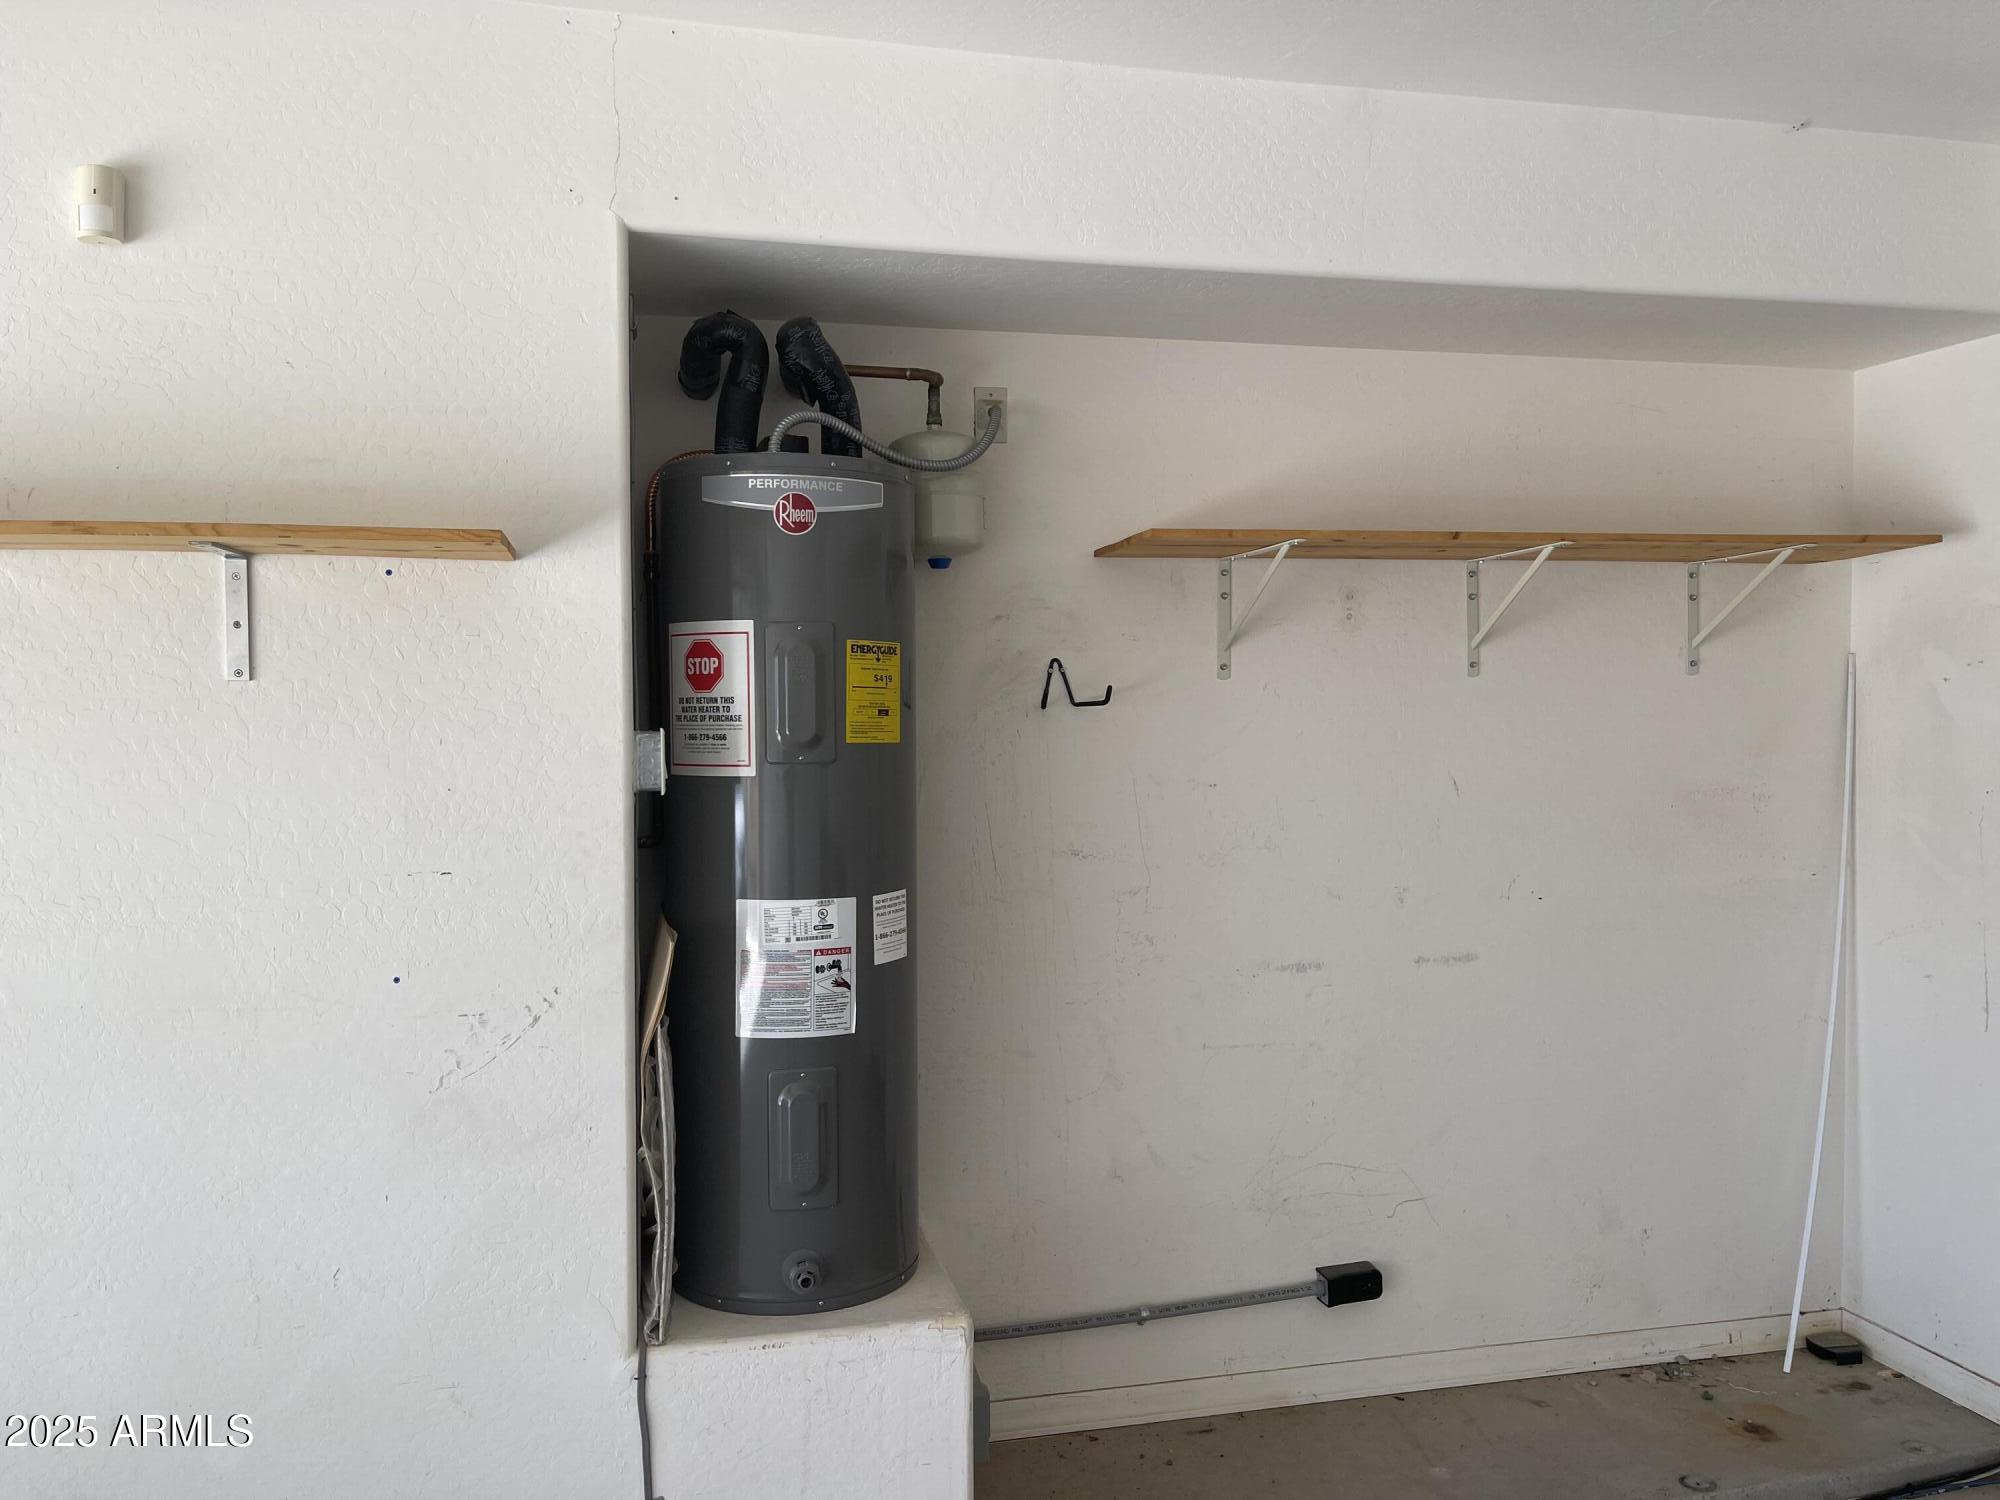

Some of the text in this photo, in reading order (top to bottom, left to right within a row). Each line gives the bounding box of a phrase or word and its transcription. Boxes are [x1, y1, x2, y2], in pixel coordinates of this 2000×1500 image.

[748, 479, 843, 491] PERFORMANCE
[779, 493, 814, 528] Rheem
[688, 657, 719, 675] STOP
